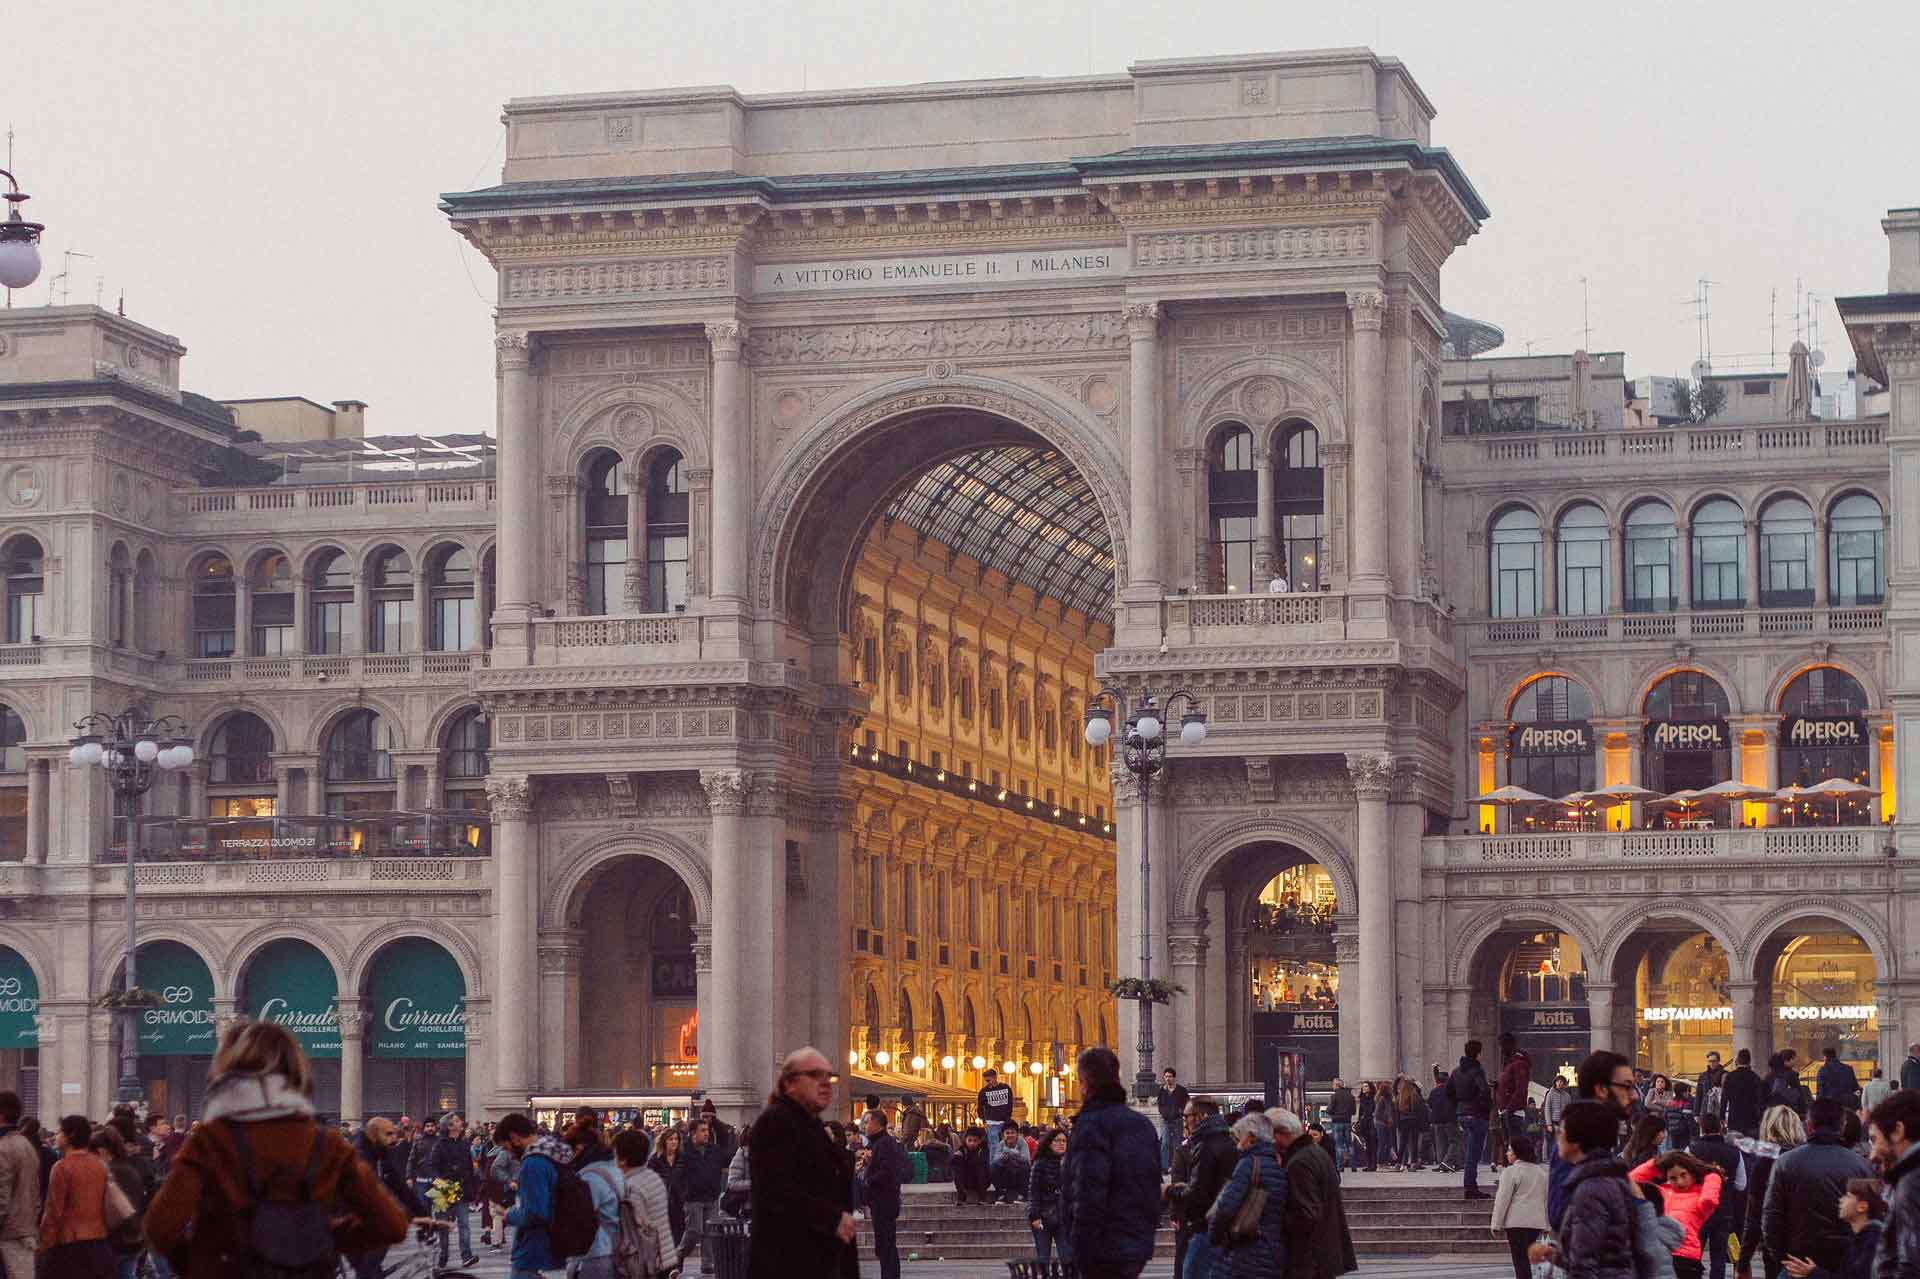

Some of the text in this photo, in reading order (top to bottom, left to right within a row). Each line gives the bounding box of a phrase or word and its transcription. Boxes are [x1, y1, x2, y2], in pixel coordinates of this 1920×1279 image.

[774, 271, 784, 285] A
[795, 268, 873, 284] VITTORIO
[883, 263, 976, 280] EMANUELE
[1031, 255, 1111, 272] MILANESI
[1655, 722, 1722, 743] APEROL
[1791, 719, 1860, 739] APEROL
[1520, 727, 1586, 747] APEROL
[221, 839, 270, 849] TERRAZZA
[271, 838, 306, 847] DUOMO
[1534, 1010, 1576, 1025] Motta
[1779, 1005, 1877, 1020] FOOD MARKET
[418, 1025, 464, 1033] GIOIELLERIE
[1293, 1014, 1334, 1029] Motta
